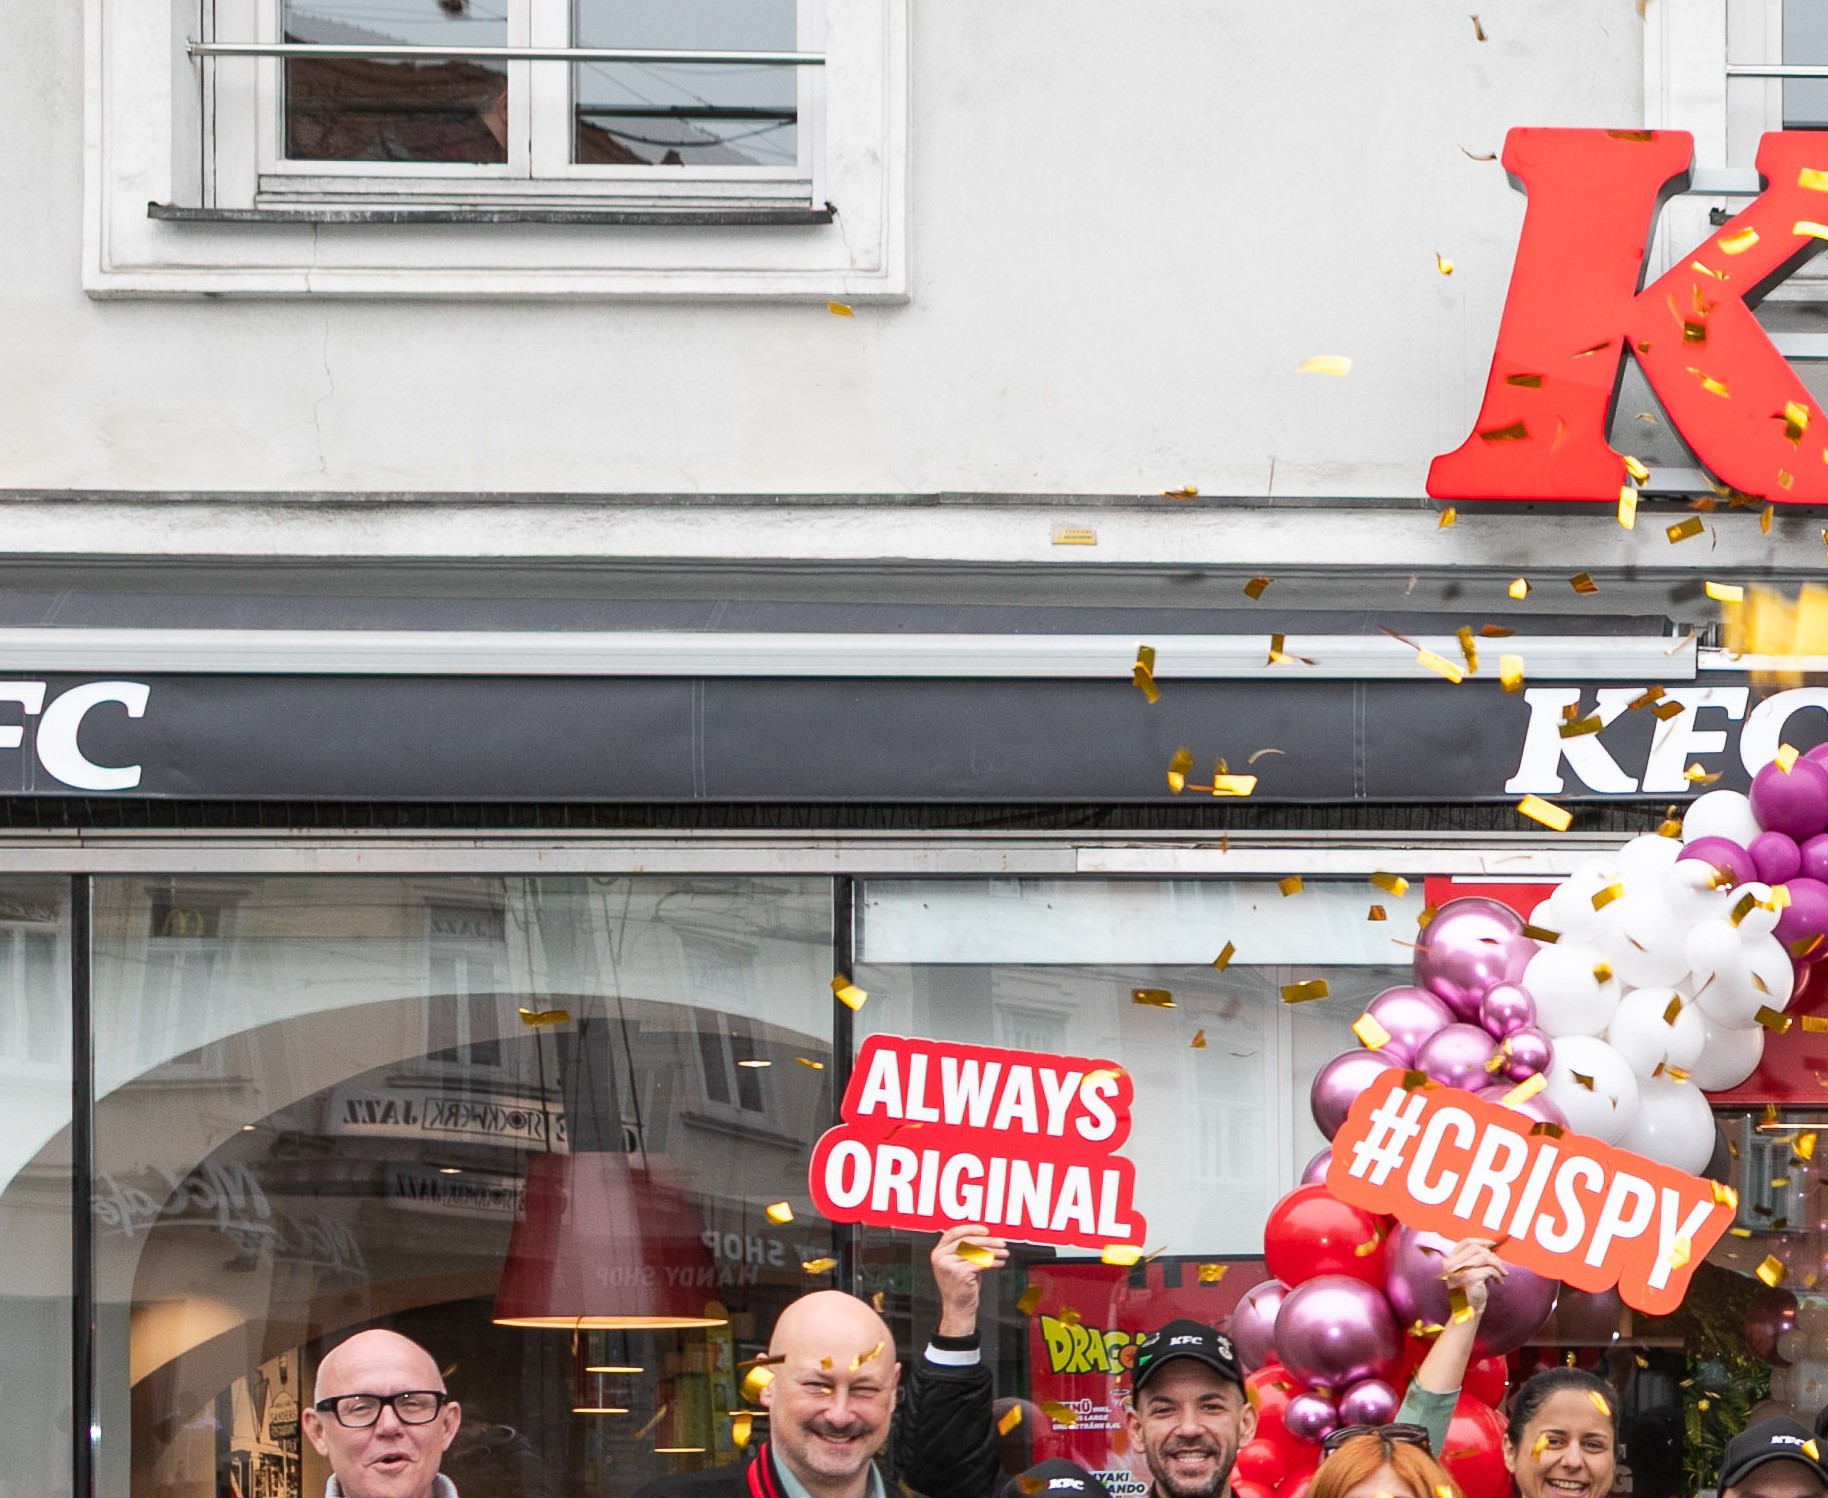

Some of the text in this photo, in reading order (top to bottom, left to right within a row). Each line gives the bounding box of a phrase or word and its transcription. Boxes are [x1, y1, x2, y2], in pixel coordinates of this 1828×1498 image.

[858, 1050, 1119, 1141] ALWAYS
[825, 1141, 1131, 1238] ORIGINAL
[1349, 1087, 1714, 1290] #CRISPY
[1169, 1335, 1203, 1346] KFC
[1049, 1478, 1084, 1490] KFC
